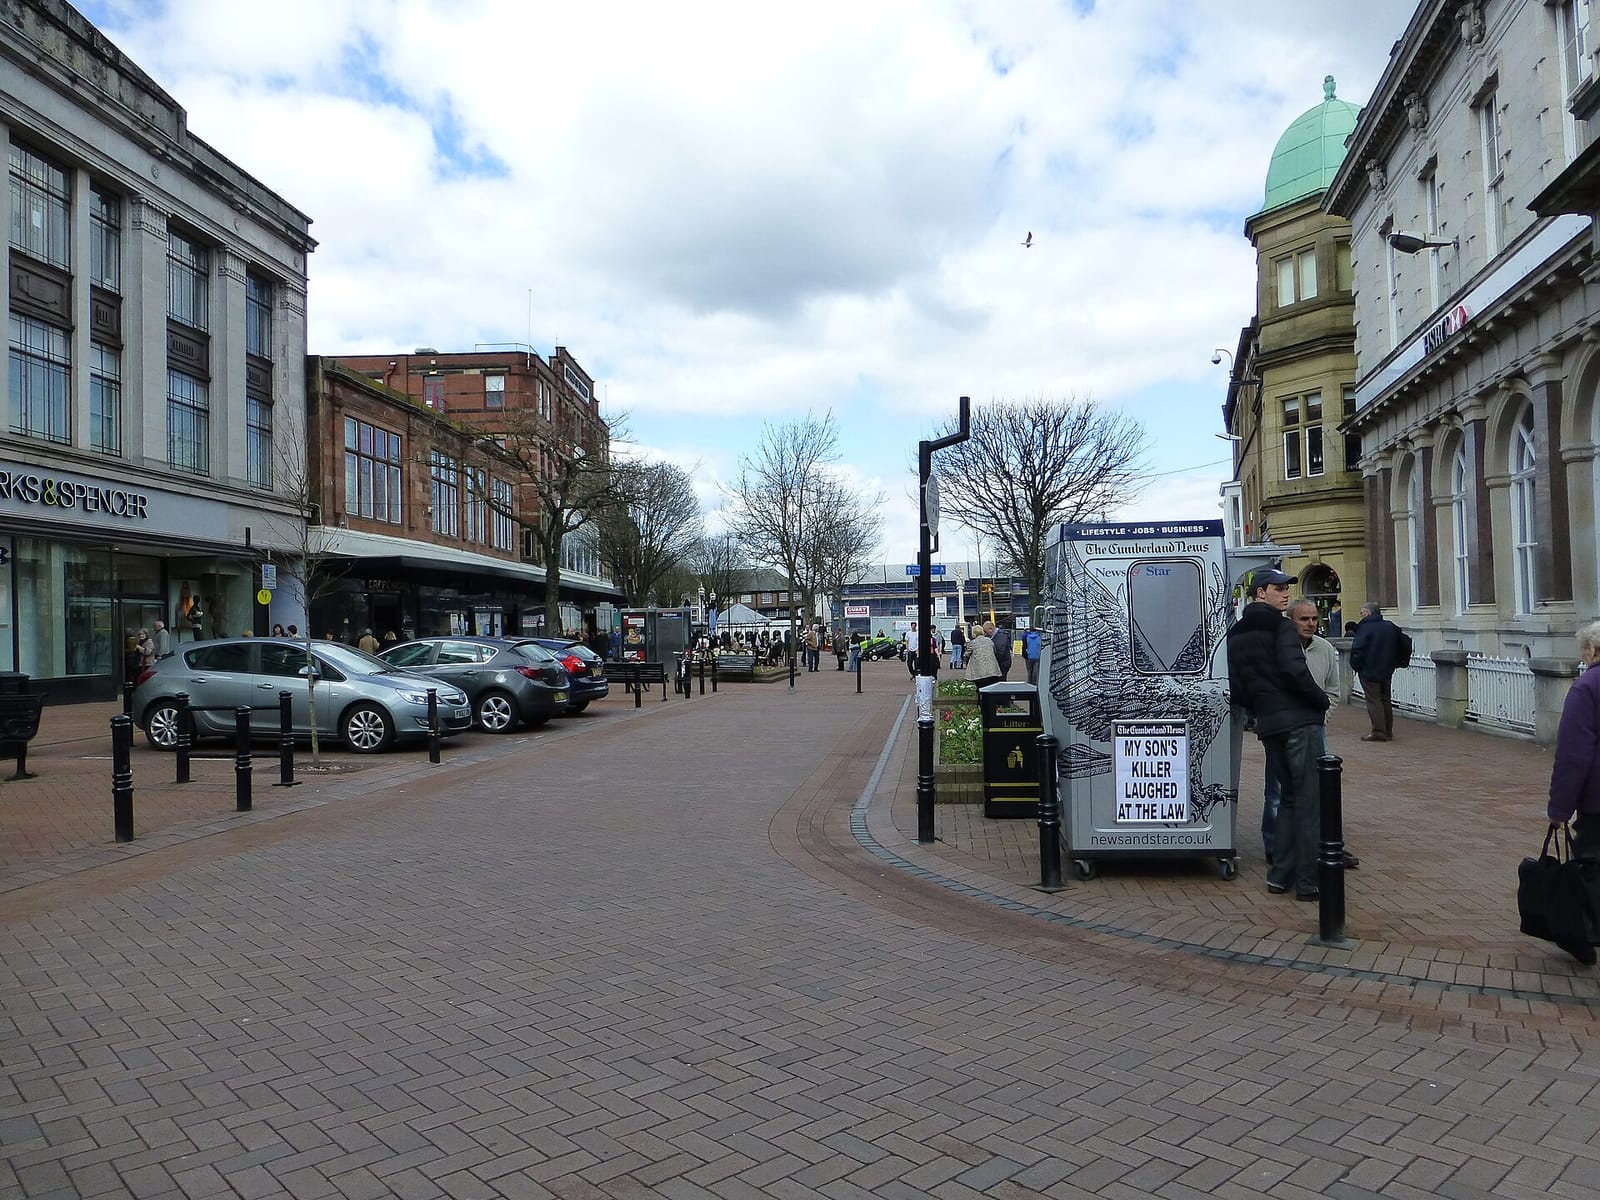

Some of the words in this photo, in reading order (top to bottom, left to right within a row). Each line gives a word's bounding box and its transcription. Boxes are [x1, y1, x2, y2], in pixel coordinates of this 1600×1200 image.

[1081, 527, 1126, 536] LIFESTYLE
[1132, 526, 1155, 535] JOBS
[1161, 525, 1205, 534] BUSINESS
[1085, 543, 1107, 556] The
[1108, 541, 1174, 555] Cumberland
[1175, 541, 1210, 553] News
[1095, 567, 1127, 578] News
[1145, 566, 1171, 577] Star
[1003, 719, 1026, 728] Litter
[1117, 725, 1130, 735] The
[1130, 725, 1167, 735] Cumberland
[1166, 724, 1185, 735] News
[1124, 739, 1142, 757] MY
[1145, 739, 1178, 757] SON'S
[1131, 761, 1172, 778] KILLER
[1125, 782, 1178, 799] LAUGHED
[1118, 803, 1132, 820] AT
[1135, 803, 1157, 820] THE
[1161, 803, 1185, 820] LAW
[1091, 833, 1213, 845] newsandstar.co.uk
